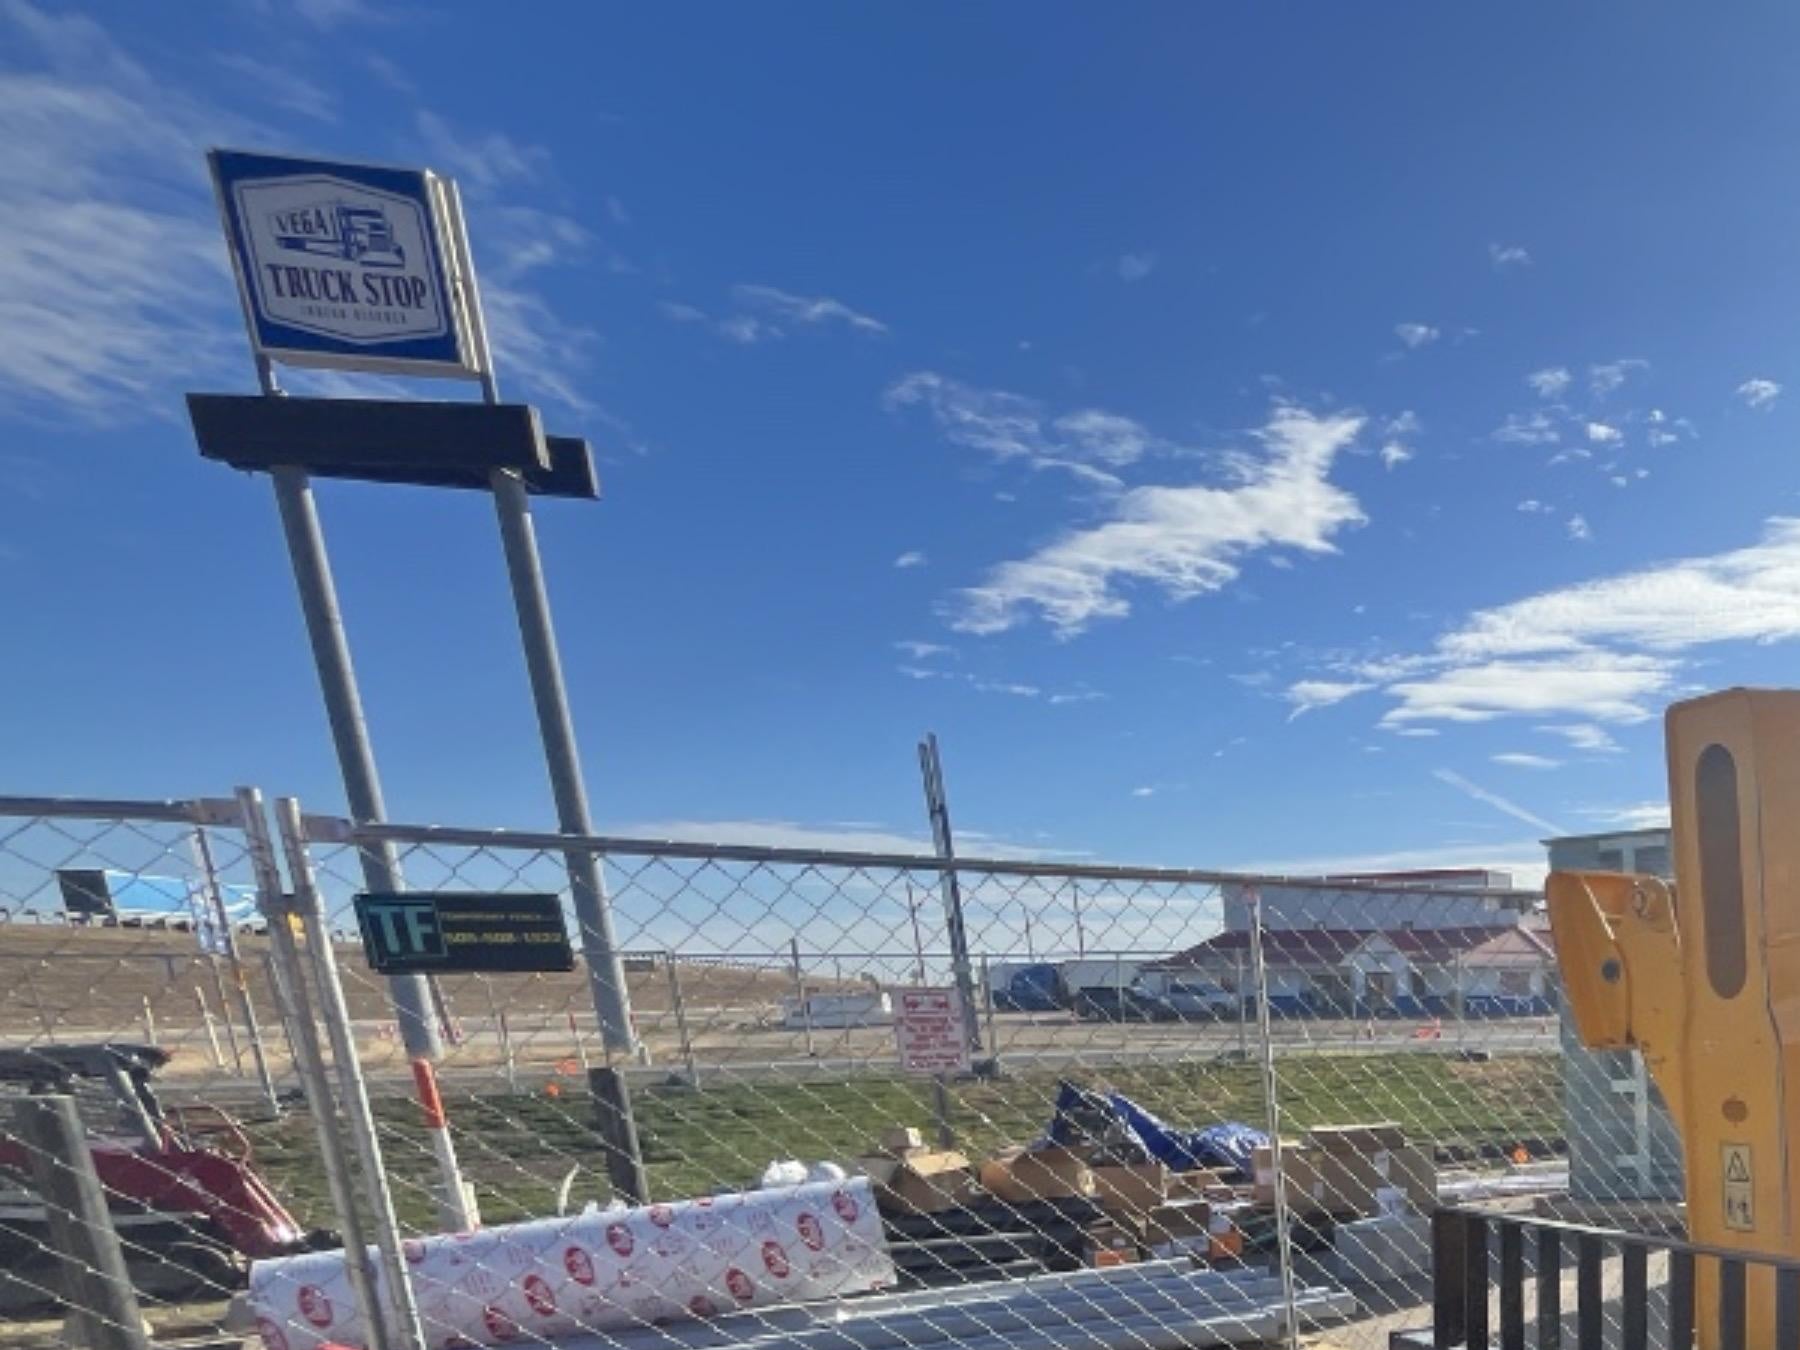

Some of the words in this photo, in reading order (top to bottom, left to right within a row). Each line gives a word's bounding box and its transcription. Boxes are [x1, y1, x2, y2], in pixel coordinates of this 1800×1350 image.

[275, 208, 329, 235] VEGA
[265, 264, 360, 304] TRUCK
[362, 272, 426, 309] STOP
[368, 905, 436, 954] TF
